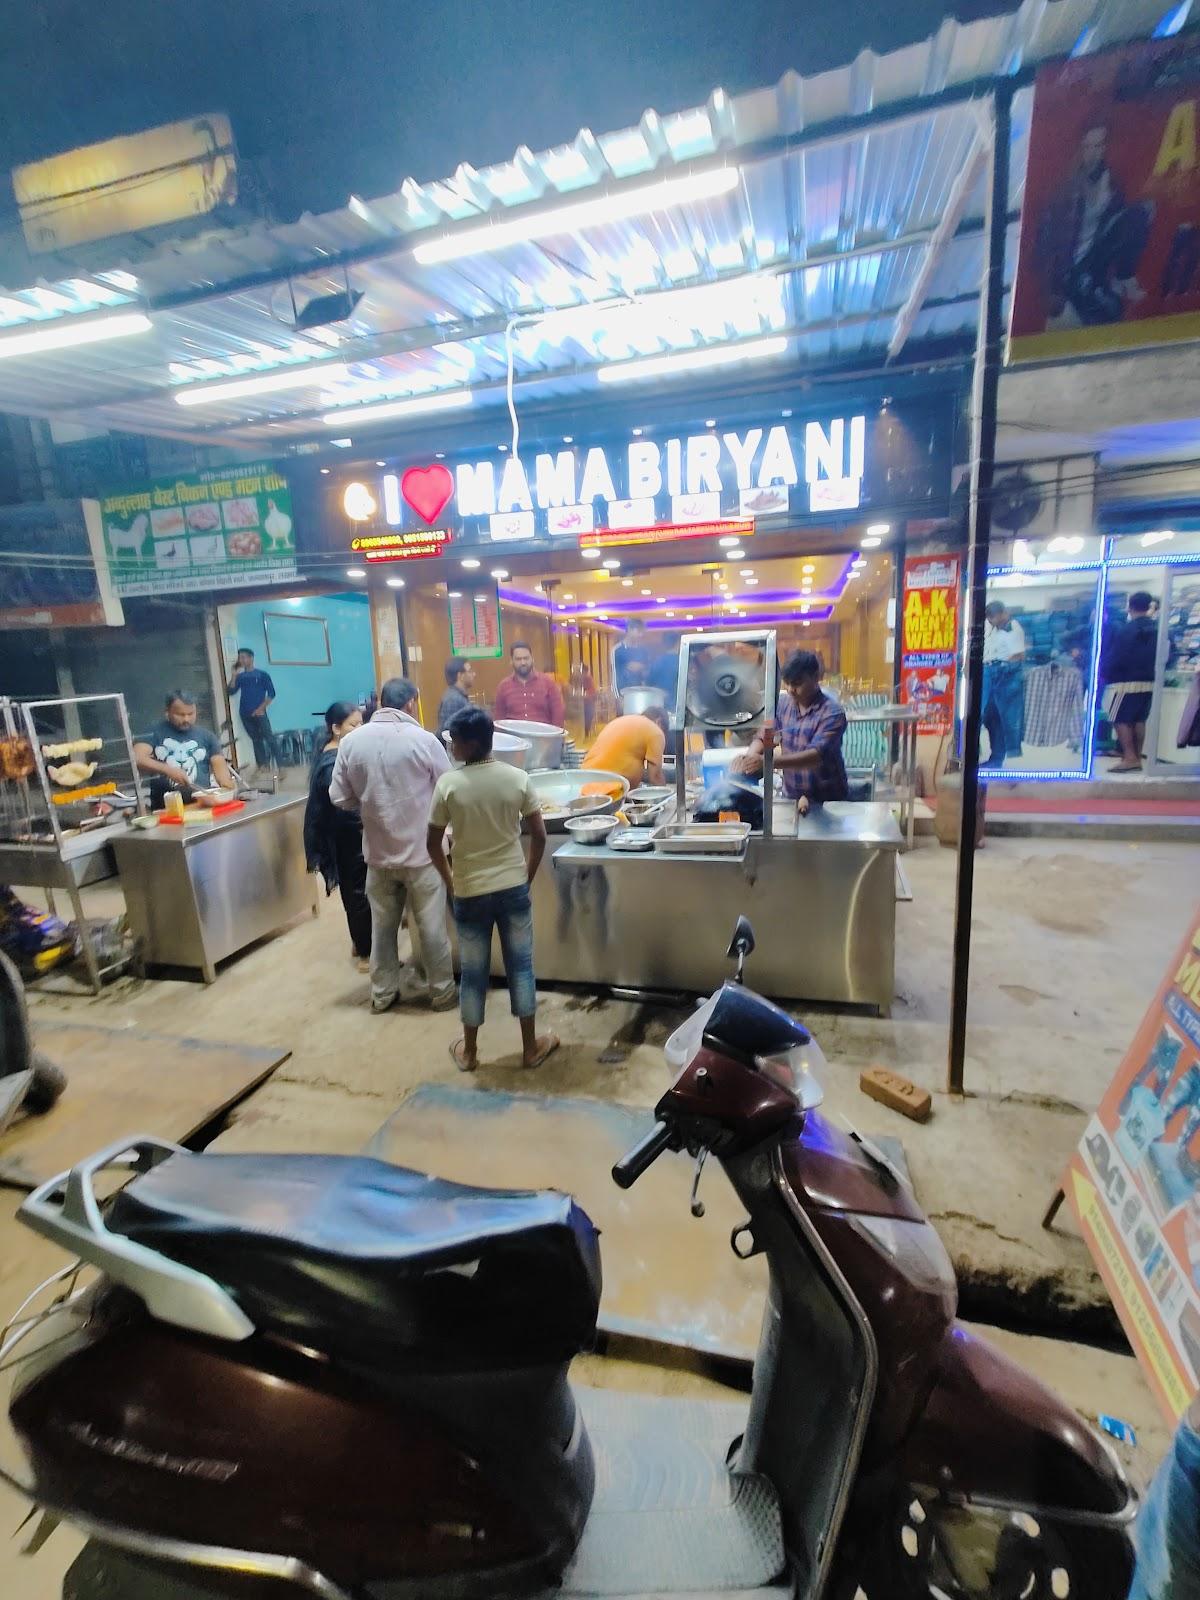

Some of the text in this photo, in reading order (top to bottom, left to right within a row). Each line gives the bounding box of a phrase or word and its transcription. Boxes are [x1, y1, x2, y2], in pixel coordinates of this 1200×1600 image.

[456, 447, 617, 516] MAMA
[628, 415, 866, 500] BIRYANI
[906, 630, 955, 651] WEAR
